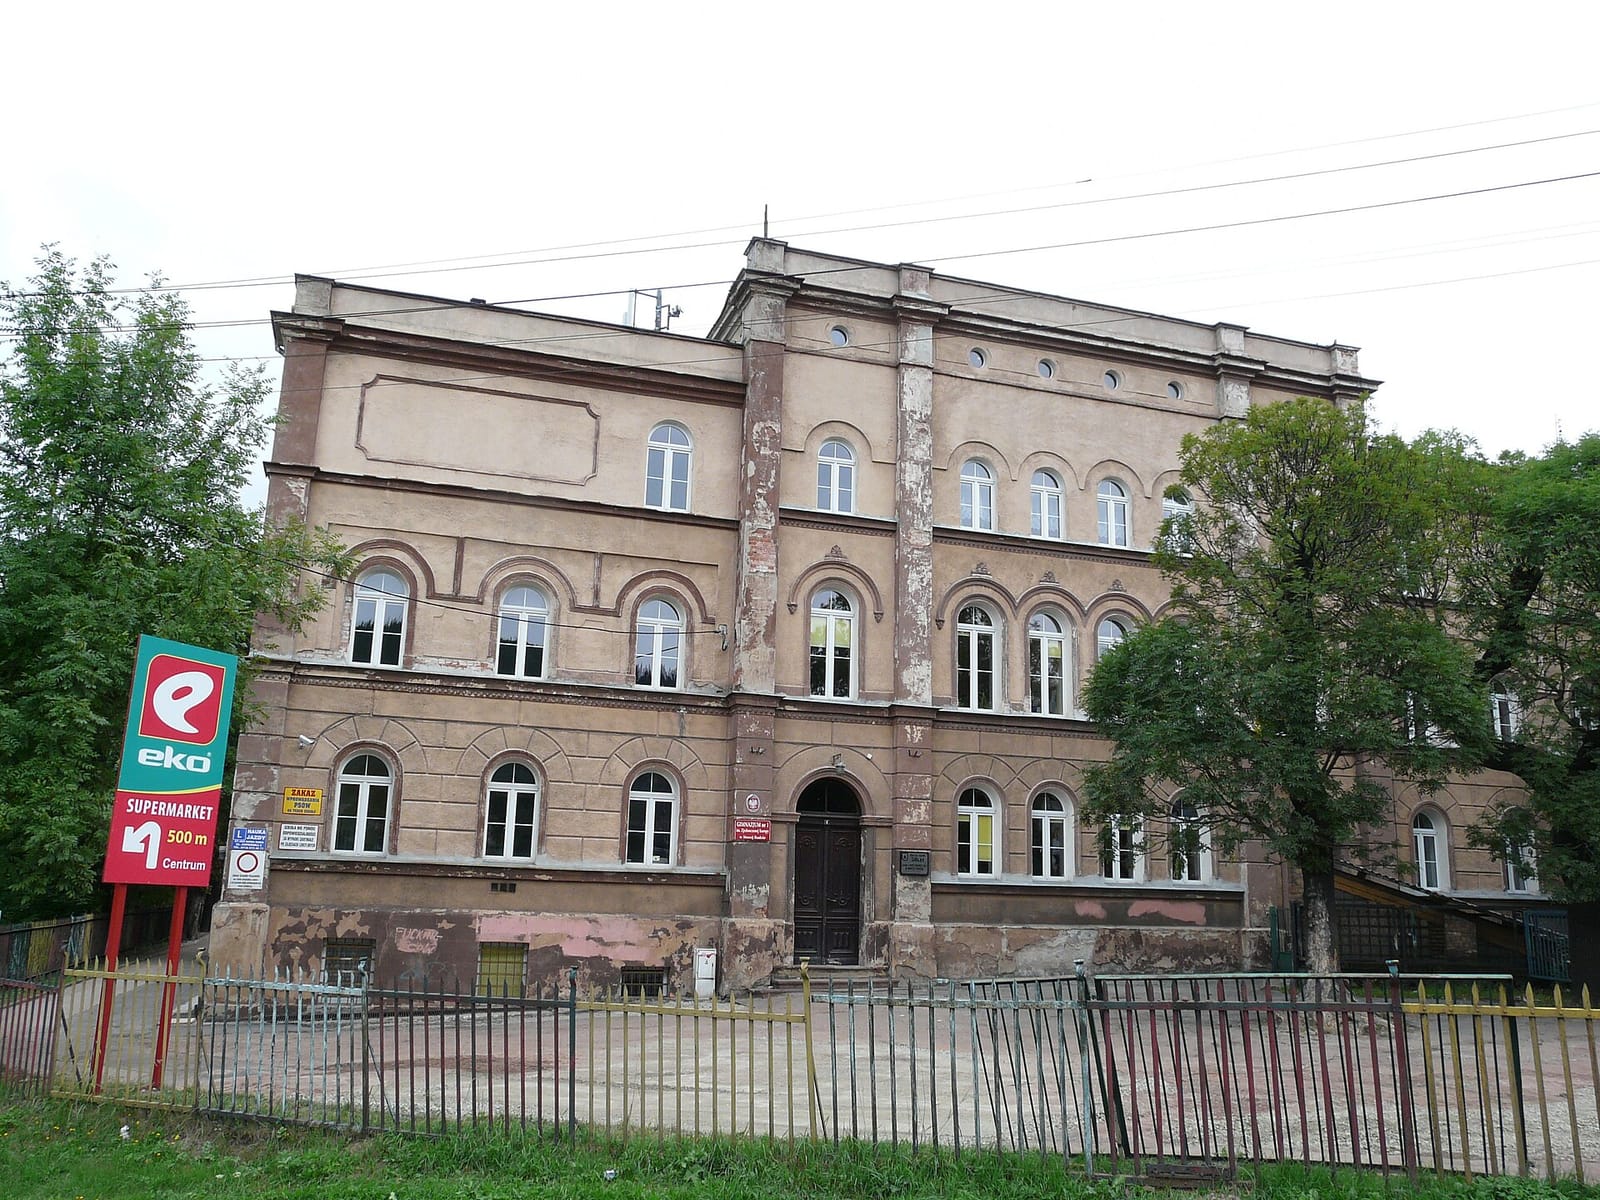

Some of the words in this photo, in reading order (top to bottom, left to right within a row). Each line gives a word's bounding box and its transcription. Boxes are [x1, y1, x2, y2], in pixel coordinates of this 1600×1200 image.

[138, 745, 211, 773] eko
[291, 789, 316, 797] ZAKAZ
[126, 798, 213, 820] SUPERMARKET
[167, 829, 193, 844] 500
[194, 835, 208, 846] m
[237, 830, 243, 838] L
[162, 857, 206, 871] Centrum
